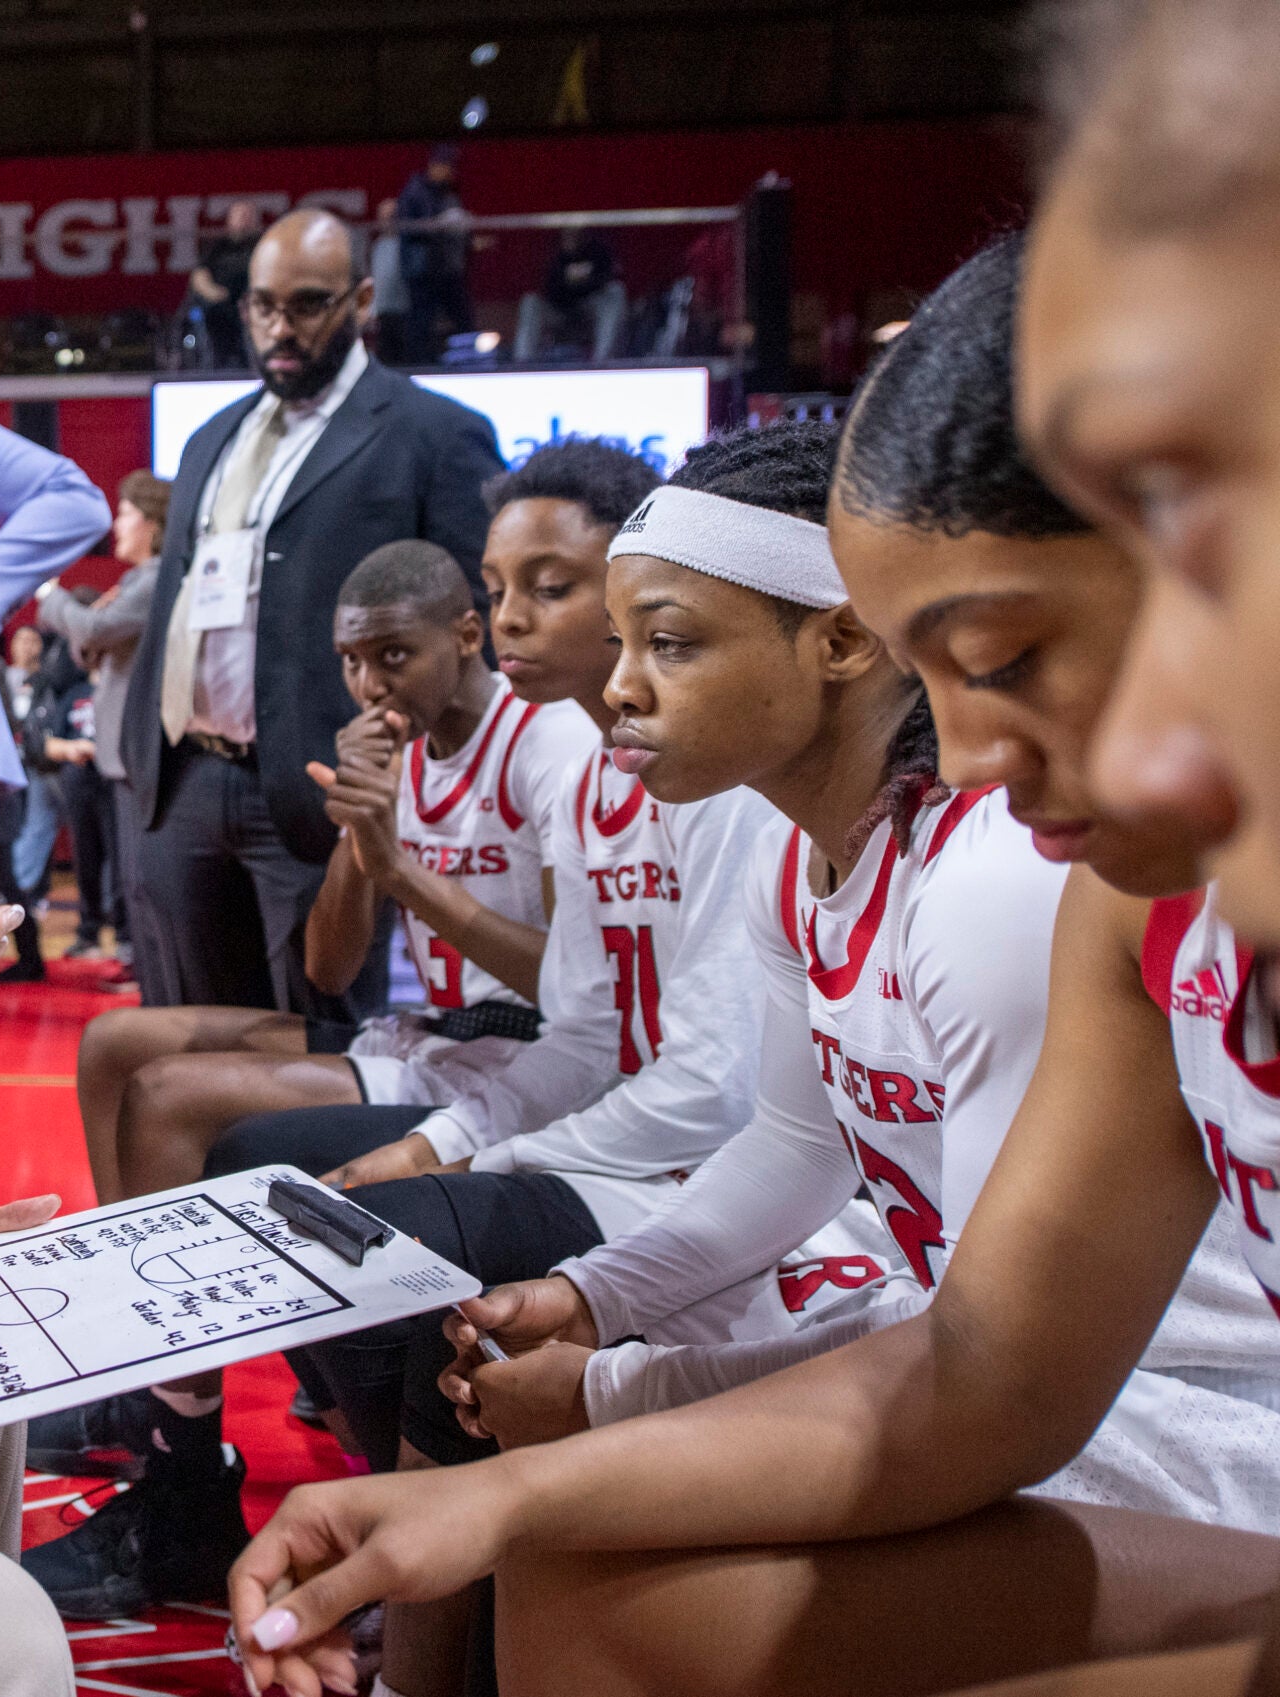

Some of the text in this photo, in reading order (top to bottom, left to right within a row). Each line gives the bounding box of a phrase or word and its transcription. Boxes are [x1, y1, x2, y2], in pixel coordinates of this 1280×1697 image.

[227, 1200, 266, 1225] FIRST
[285, 1298, 310, 1312] 24
[198, 1322, 223, 1335] 12
[163, 1330, 186, 1346] 42
